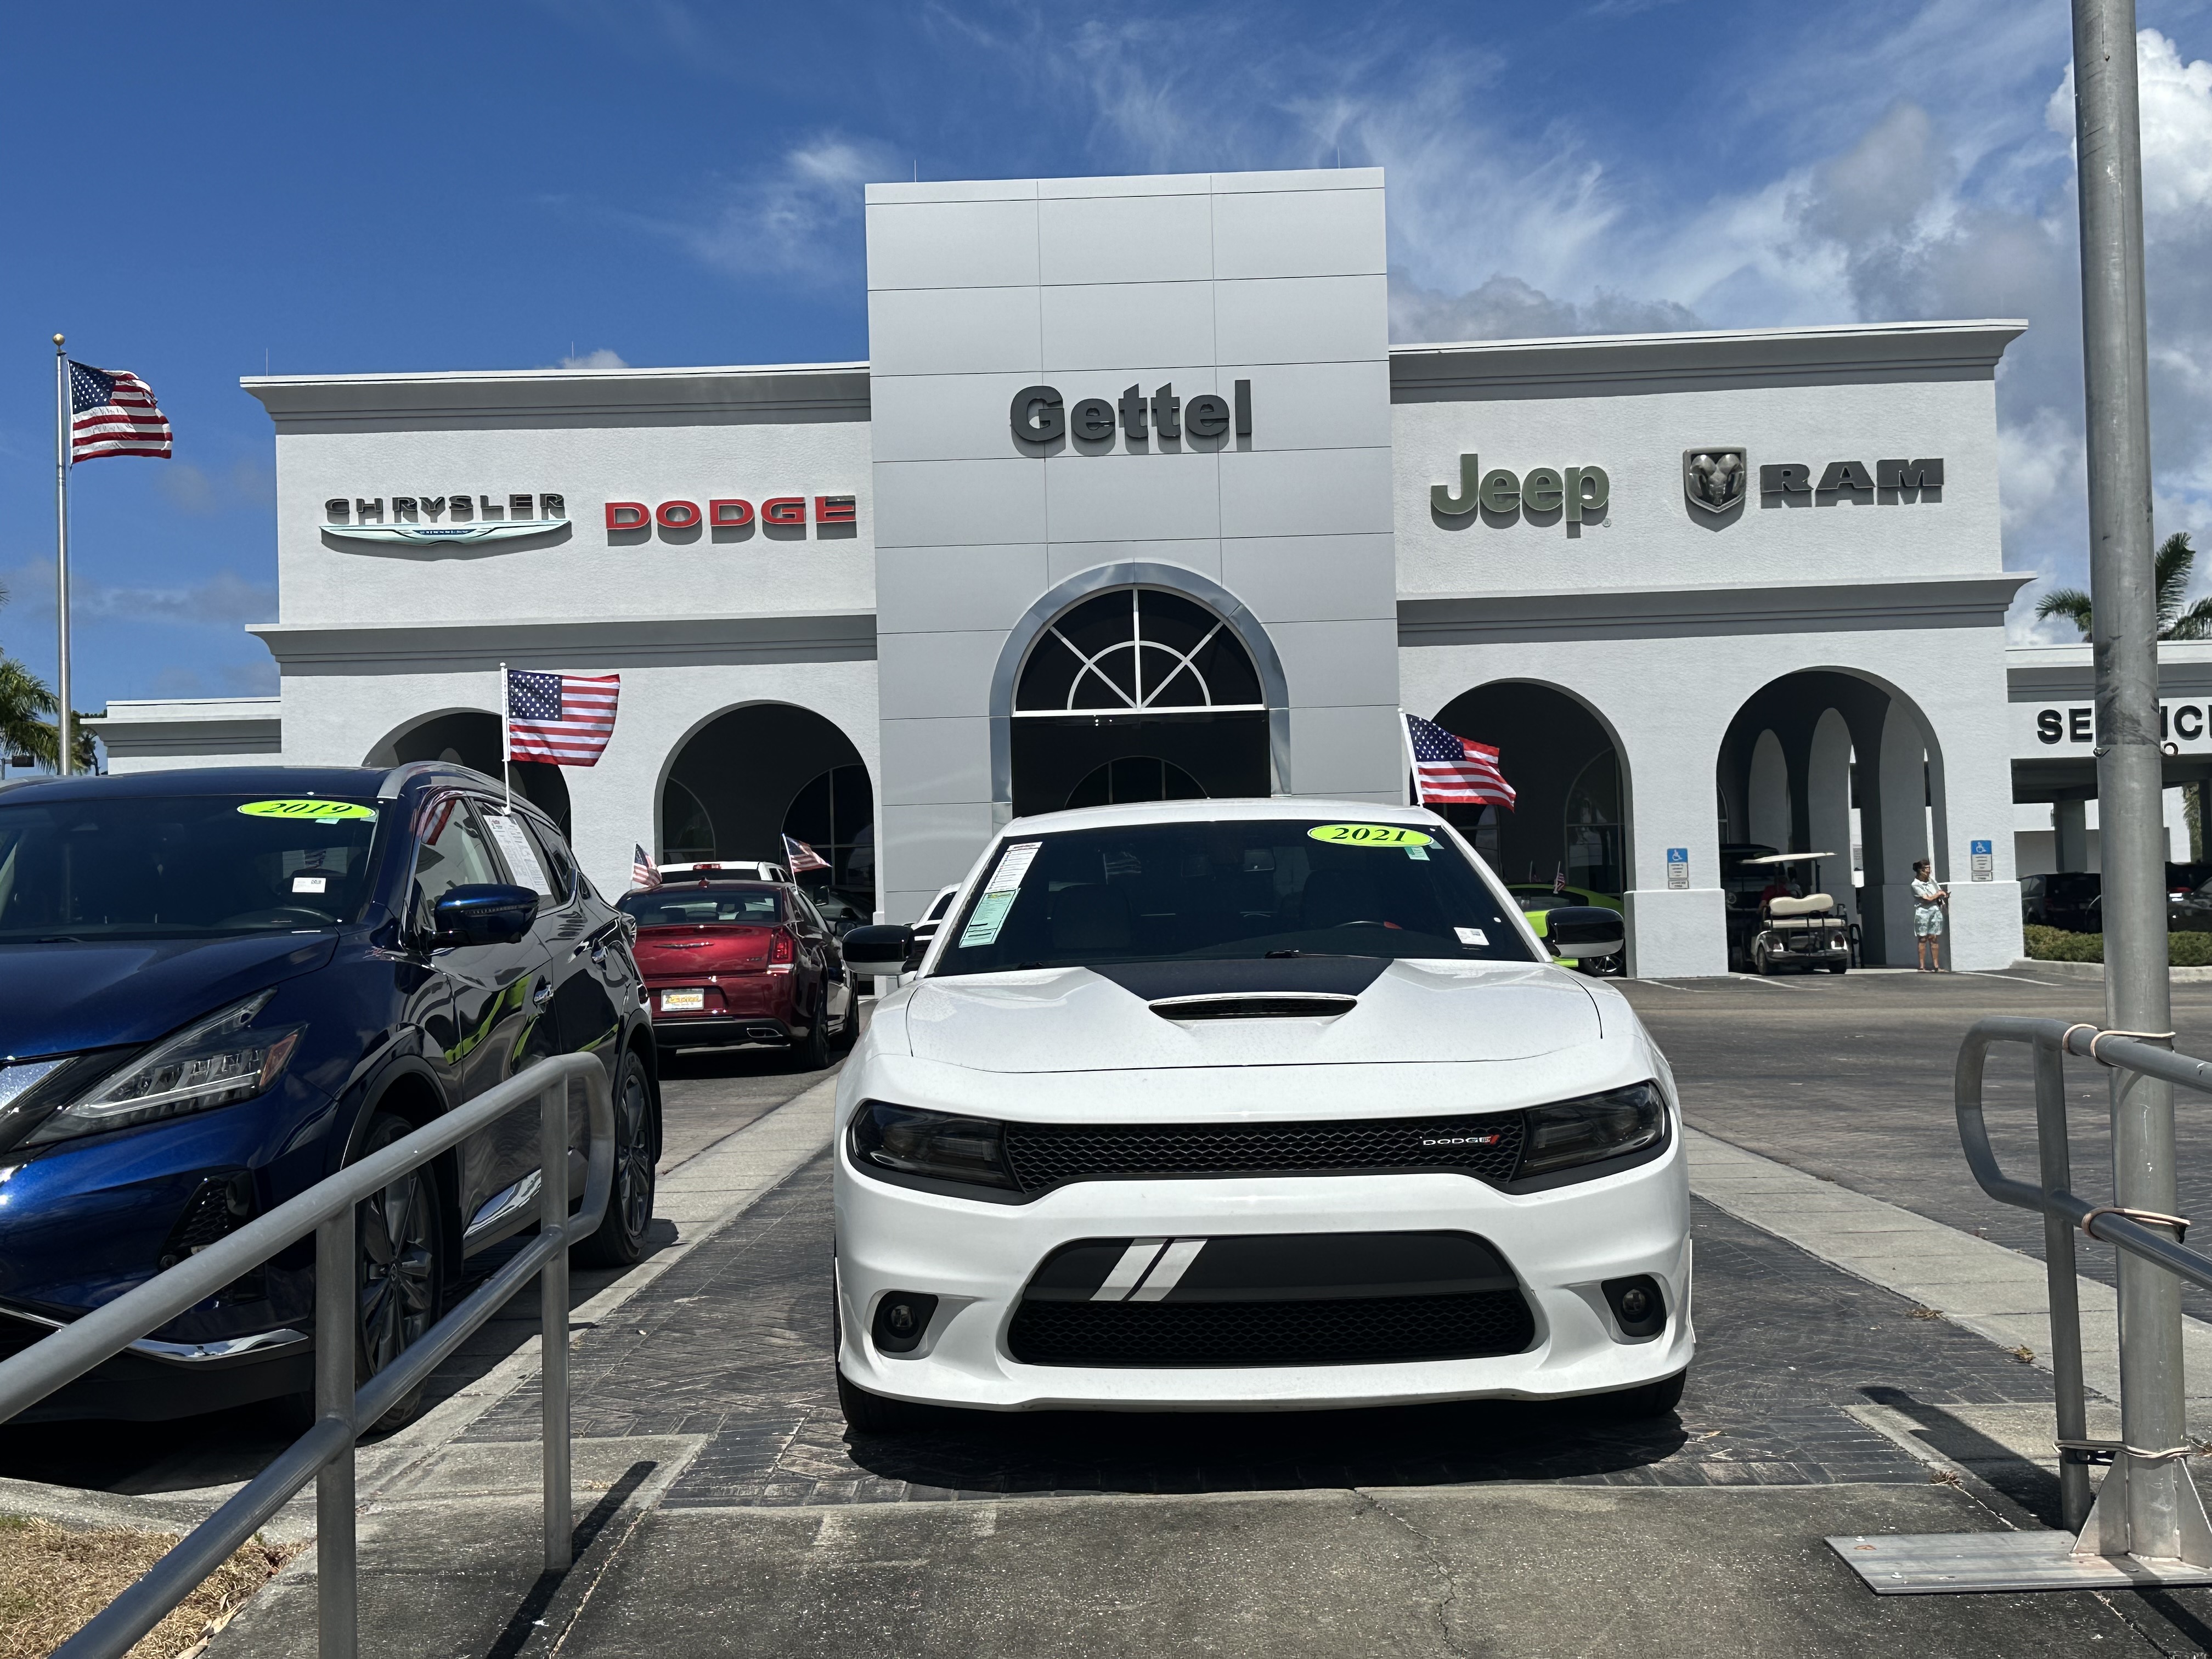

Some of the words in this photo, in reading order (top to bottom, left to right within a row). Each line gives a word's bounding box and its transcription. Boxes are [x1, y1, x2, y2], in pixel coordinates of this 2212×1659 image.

[1010, 379, 1251, 442] Gettel
[1430, 454, 1610, 521] Jeep
[1759, 458, 1944, 493] RAM
[325, 494, 565, 514] CHRYSLER
[605, 495, 856, 529] DODGE
[2037, 705, 2212, 744] SEIC
[258, 803, 352, 814] 2019
[1331, 828, 1406, 842] 2021
[1423, 1136, 1492, 1146] DODGE
